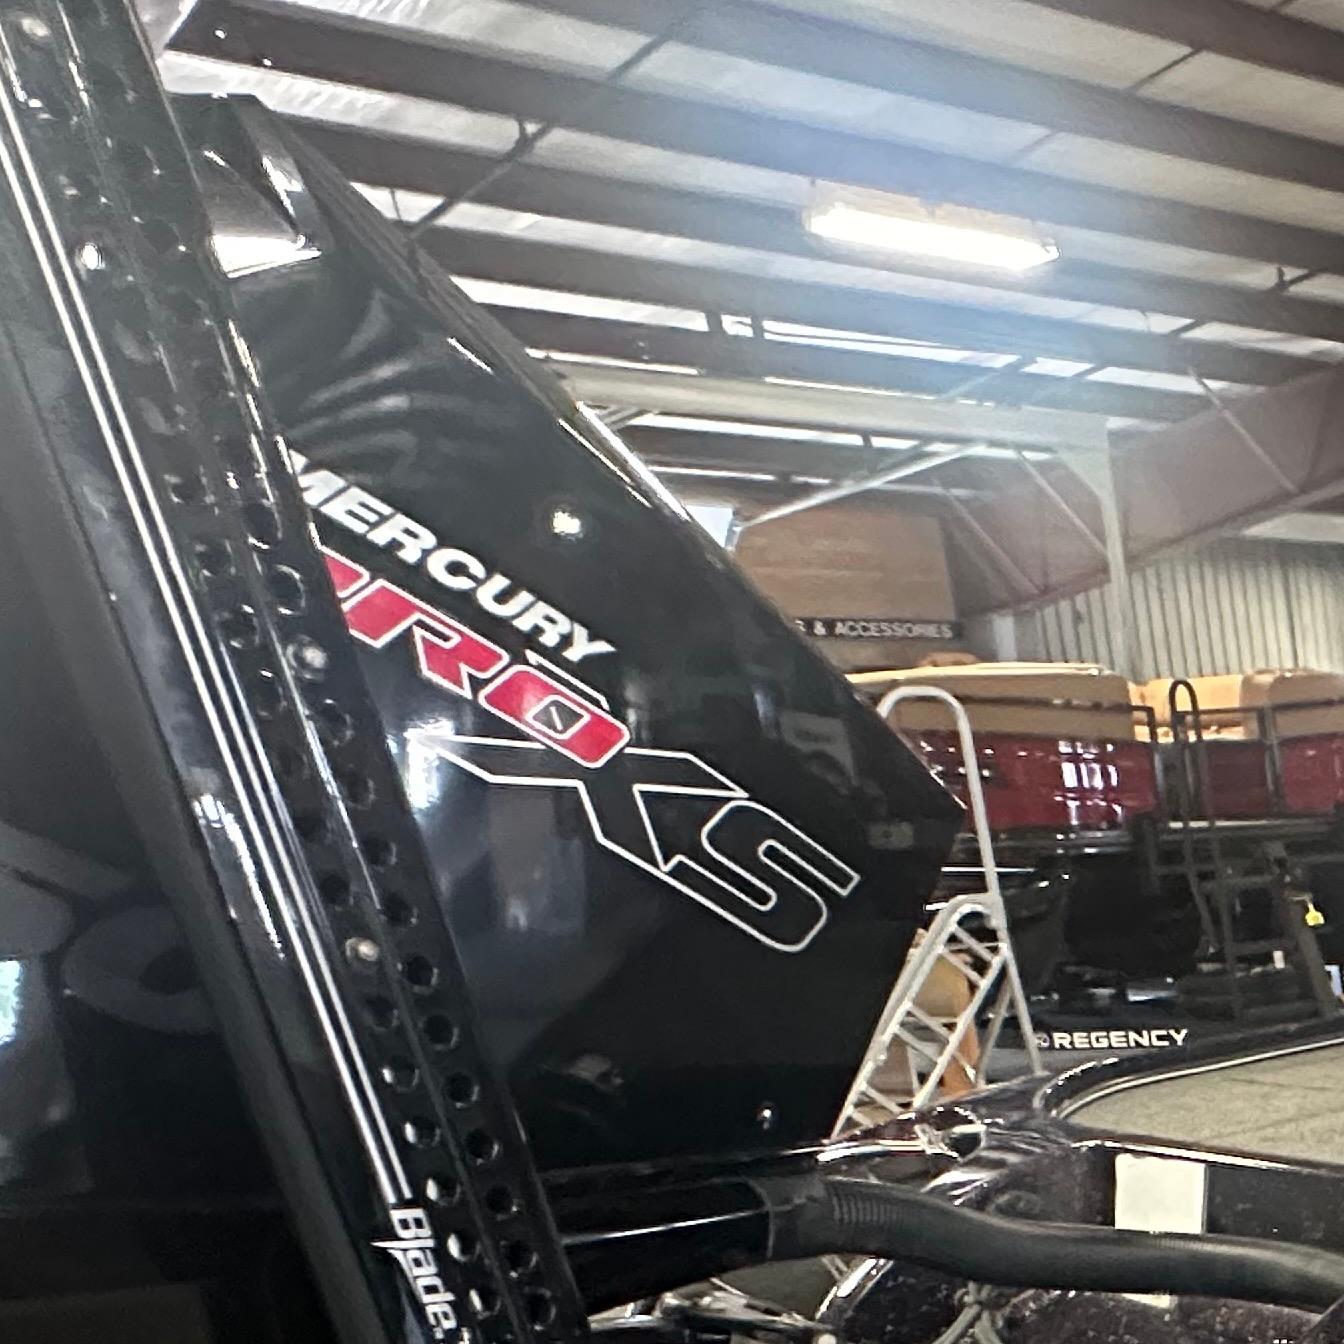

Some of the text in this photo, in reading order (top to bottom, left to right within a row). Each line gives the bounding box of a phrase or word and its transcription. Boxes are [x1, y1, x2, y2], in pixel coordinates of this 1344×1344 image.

[289, 448, 616, 663] MERCURY
[402, 732, 862, 954] XS
[1051, 1028, 1188, 1049] REGENCY
[369, 1207, 458, 1331] Blade
